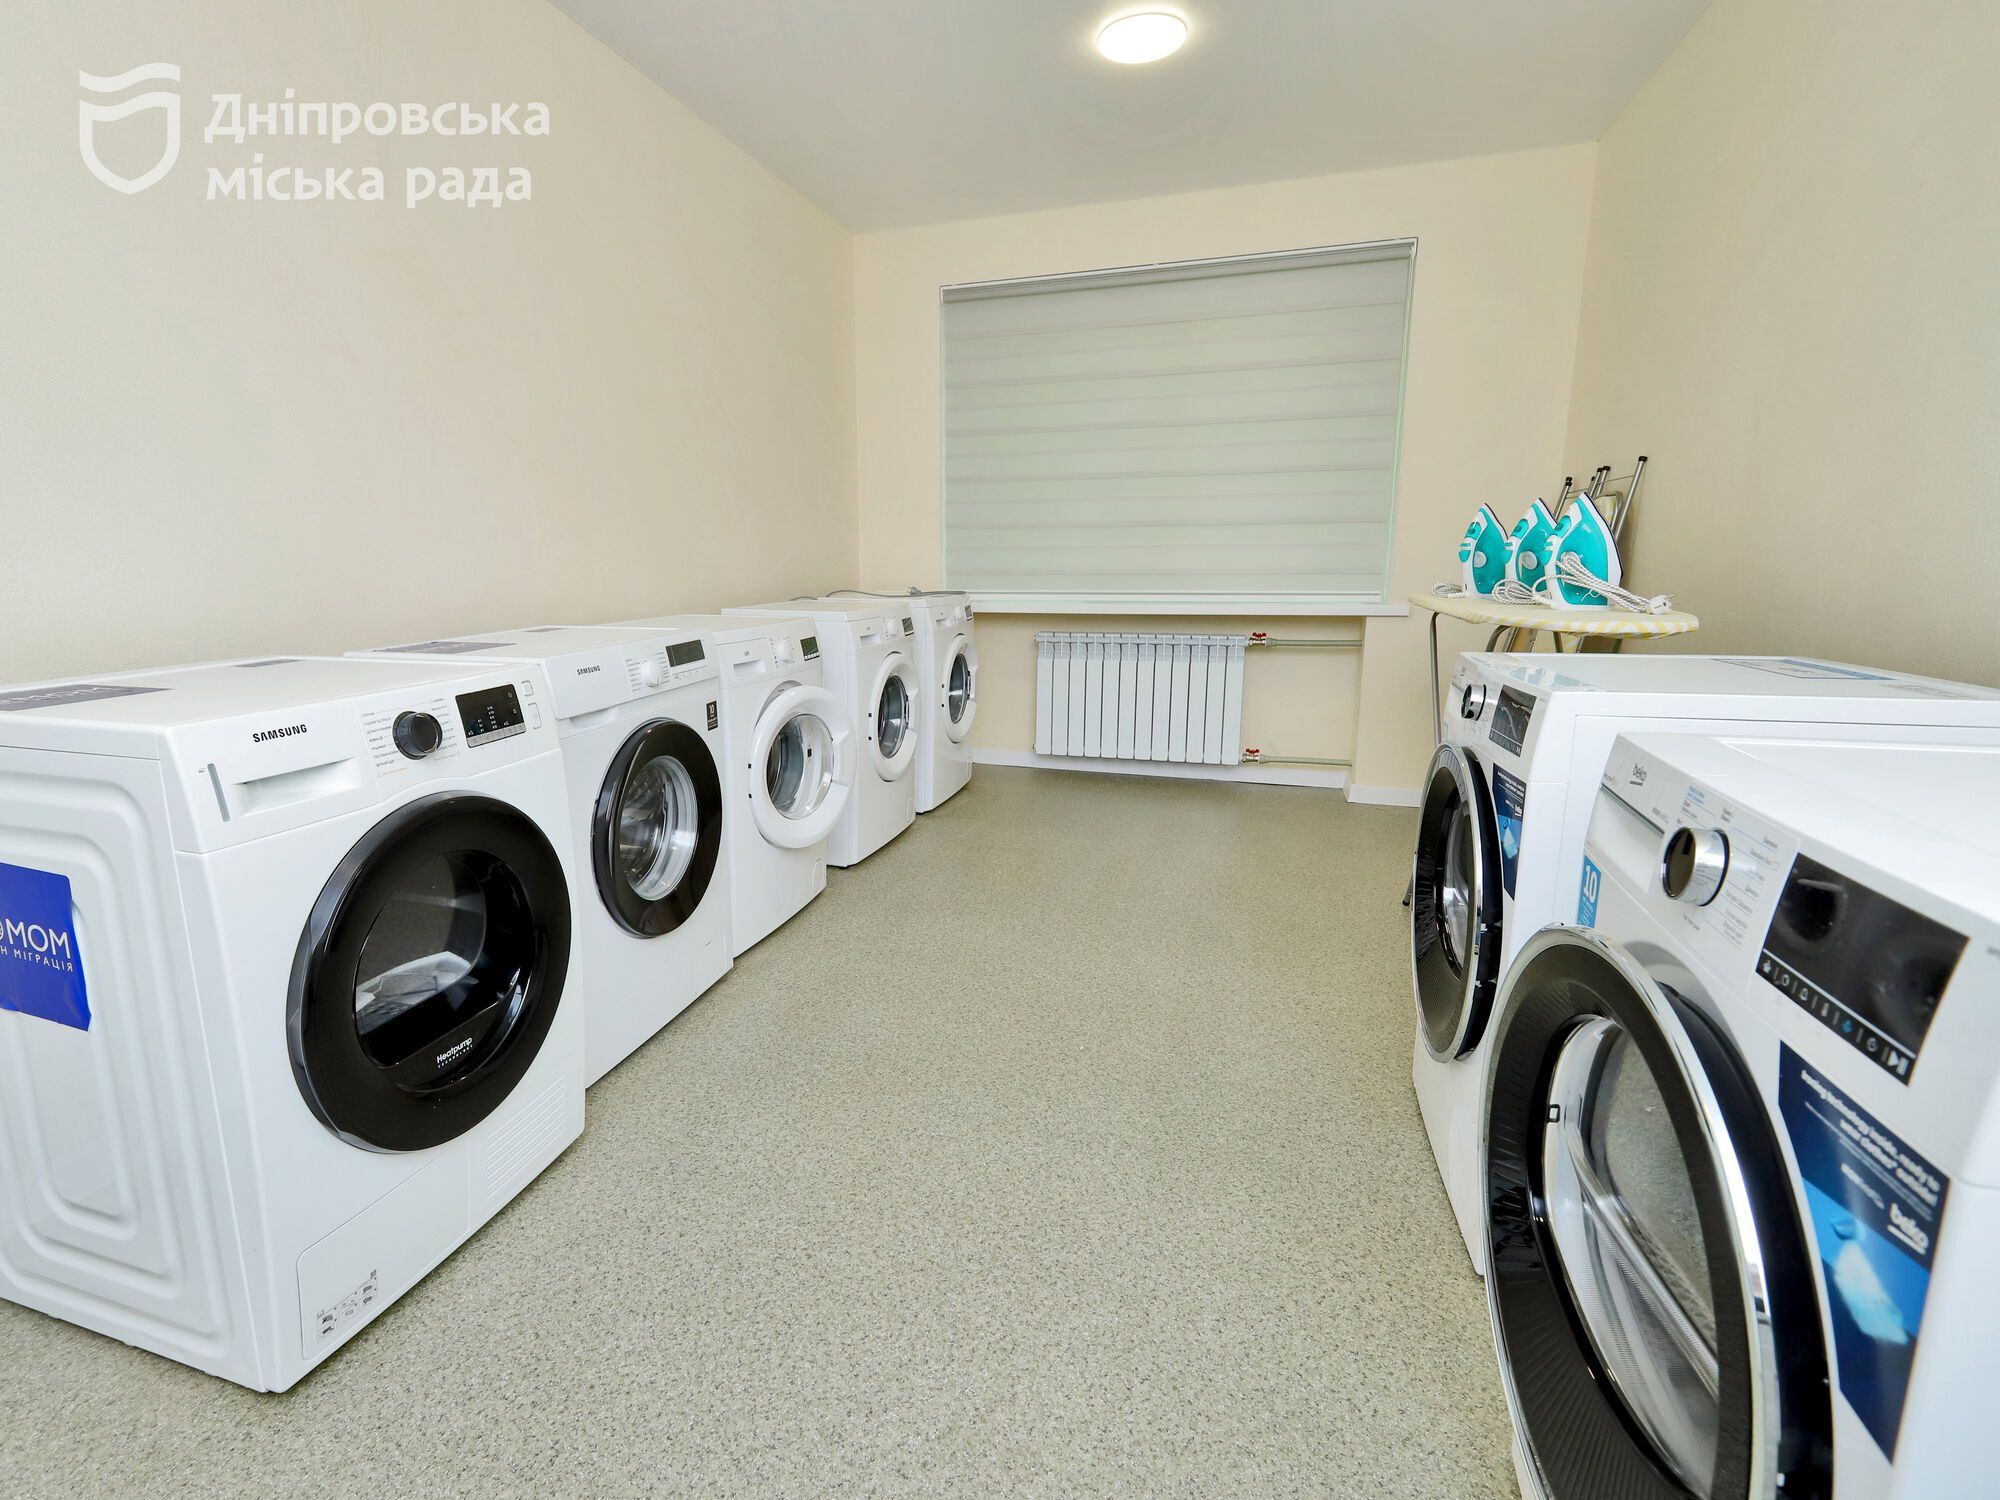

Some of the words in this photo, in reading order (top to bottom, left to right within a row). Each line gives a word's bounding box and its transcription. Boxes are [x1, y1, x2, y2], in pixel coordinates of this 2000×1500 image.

[576, 665, 601, 676] SAMSUNG
[252, 724, 307, 743] SAMSUNG
[1583, 865, 1598, 903] 10
[13, 948, 73, 973] МІГРАЦІЯ
[436, 1037, 472, 1064] Heatpump
[1889, 1202, 1929, 1251] beko
